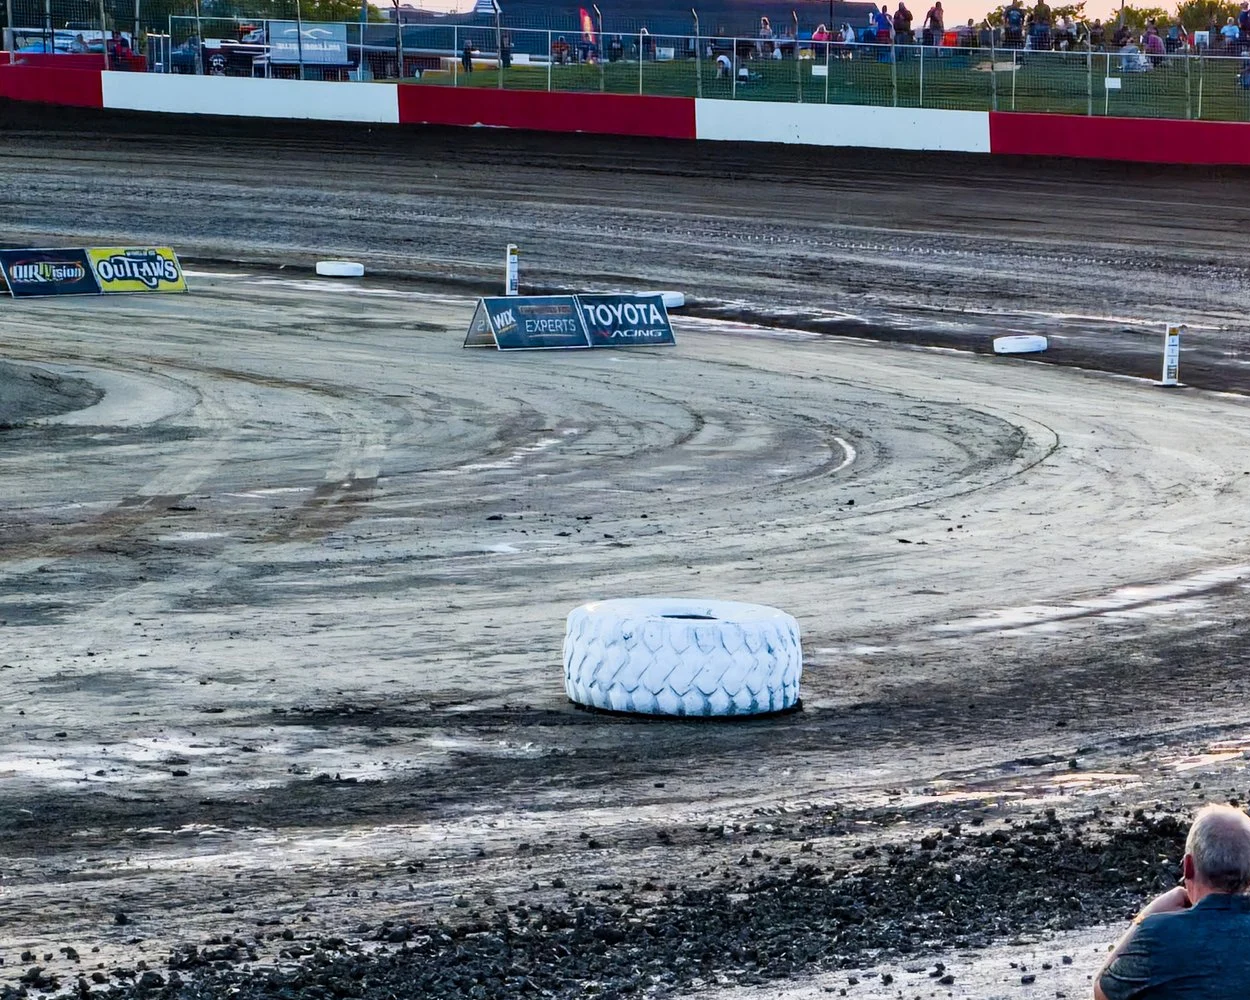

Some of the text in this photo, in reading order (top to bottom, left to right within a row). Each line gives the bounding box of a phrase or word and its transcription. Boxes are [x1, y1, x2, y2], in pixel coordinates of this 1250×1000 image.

[493, 308, 516, 329] WIX
[583, 303, 666, 326] TOYOTA
[525, 319, 577, 332] EXPERTS
